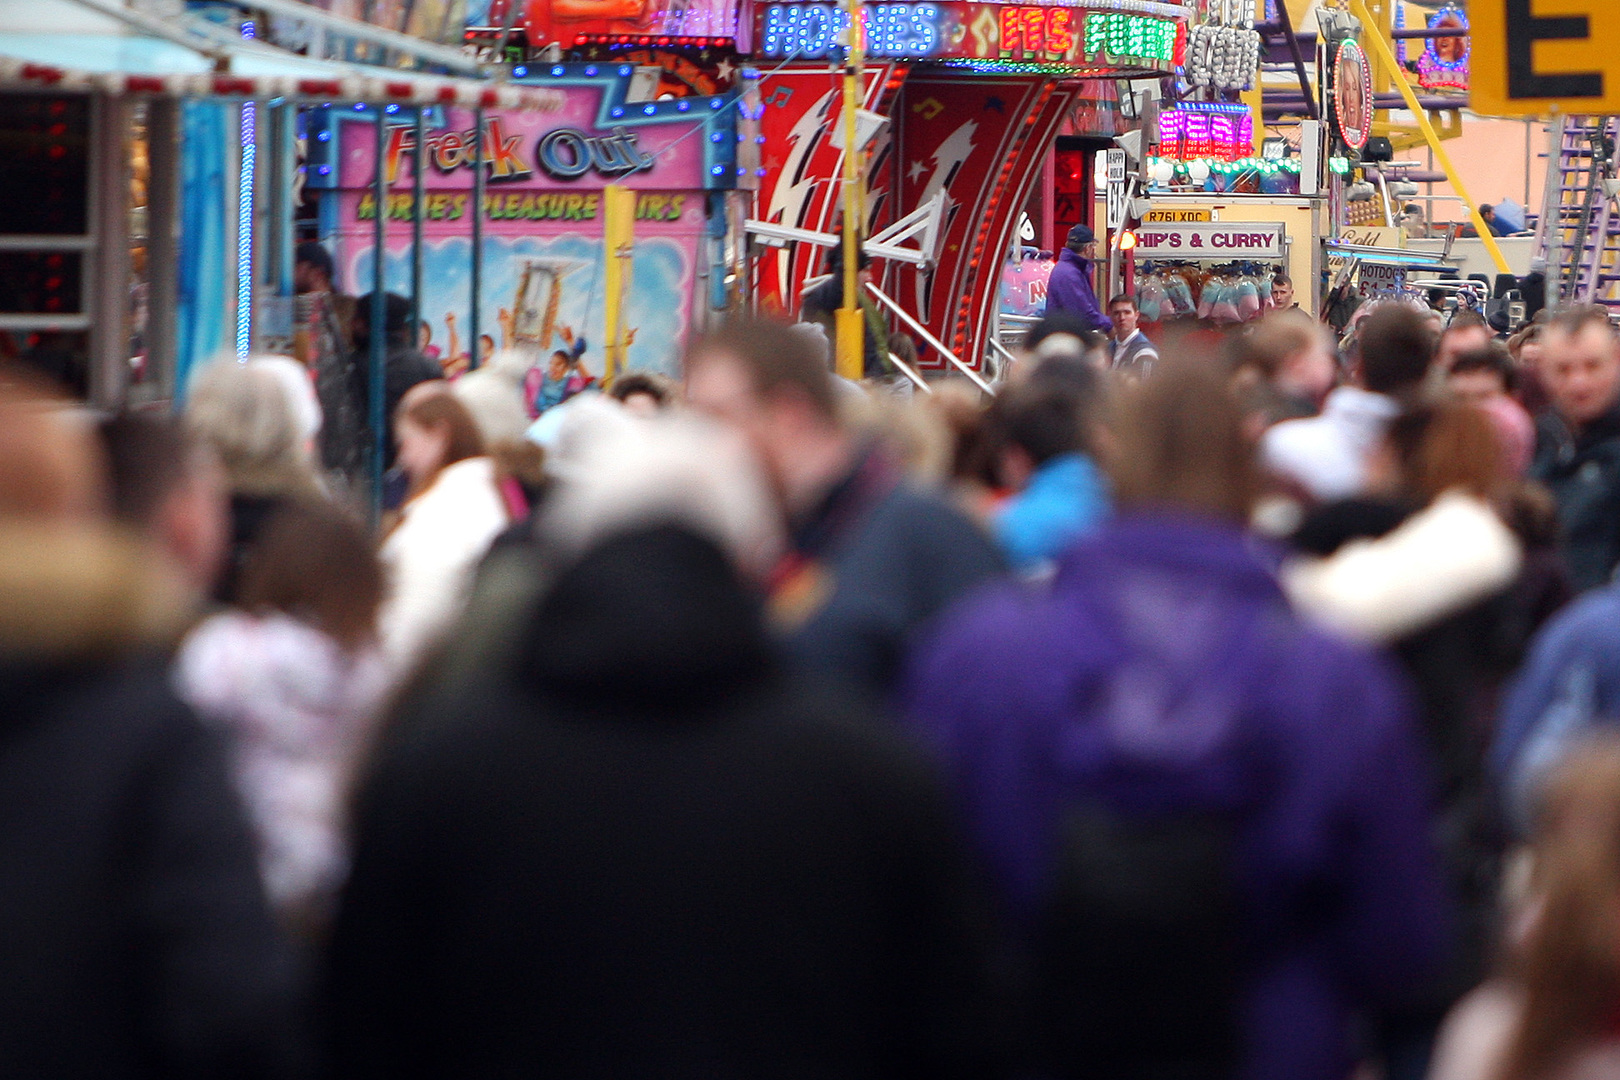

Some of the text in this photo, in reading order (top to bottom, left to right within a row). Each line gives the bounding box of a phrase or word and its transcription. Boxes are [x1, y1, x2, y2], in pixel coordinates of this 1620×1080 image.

[1150, 212, 1203, 222] R761 XDC
[1189, 234, 1203, 248] &
[1211, 233, 1274, 248] CURRY
[1360, 265, 1406, 279] HOTDOGS
